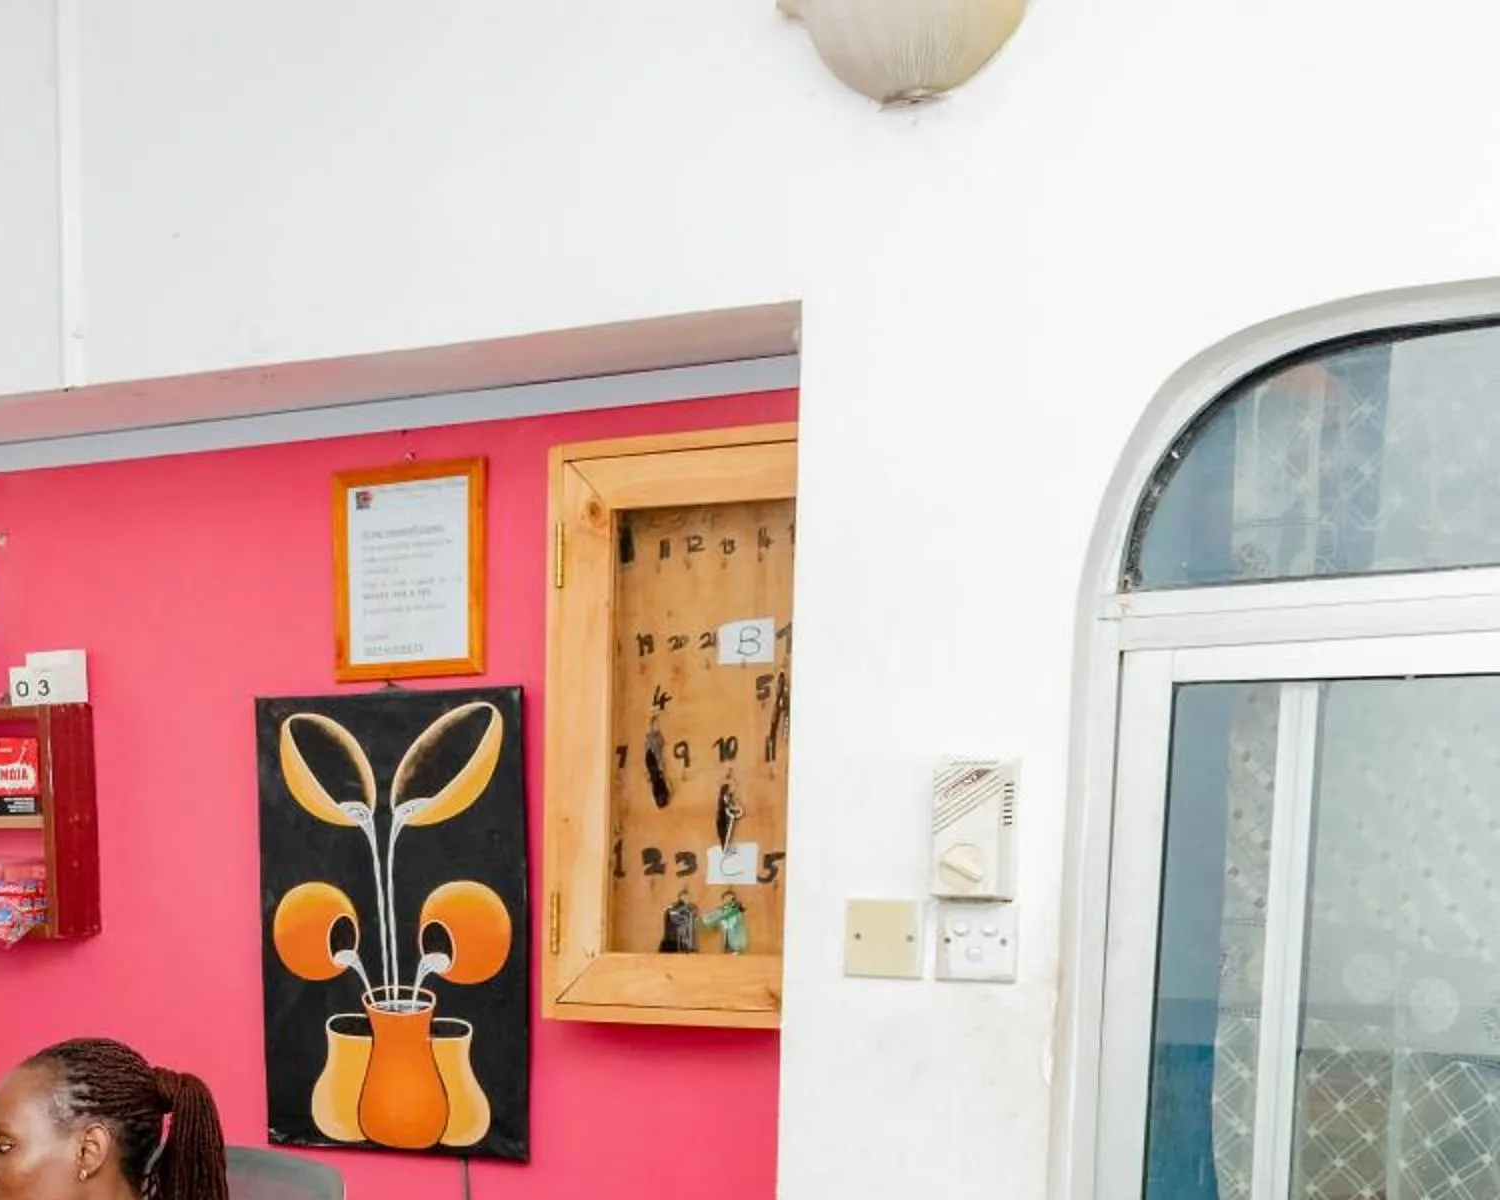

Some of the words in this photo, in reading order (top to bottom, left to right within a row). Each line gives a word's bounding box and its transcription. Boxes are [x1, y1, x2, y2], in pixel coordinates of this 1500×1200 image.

[686, 535, 704, 552] 12
[736, 625, 762, 657] B
[652, 685, 673, 711] 4
[755, 674, 774, 701] 5
[673, 741, 690, 769] 9
[712, 735, 739, 763] 10
[641, 847, 668, 876] 2
[674, 851, 699, 878] 3
[756, 851, 787, 884] 5
